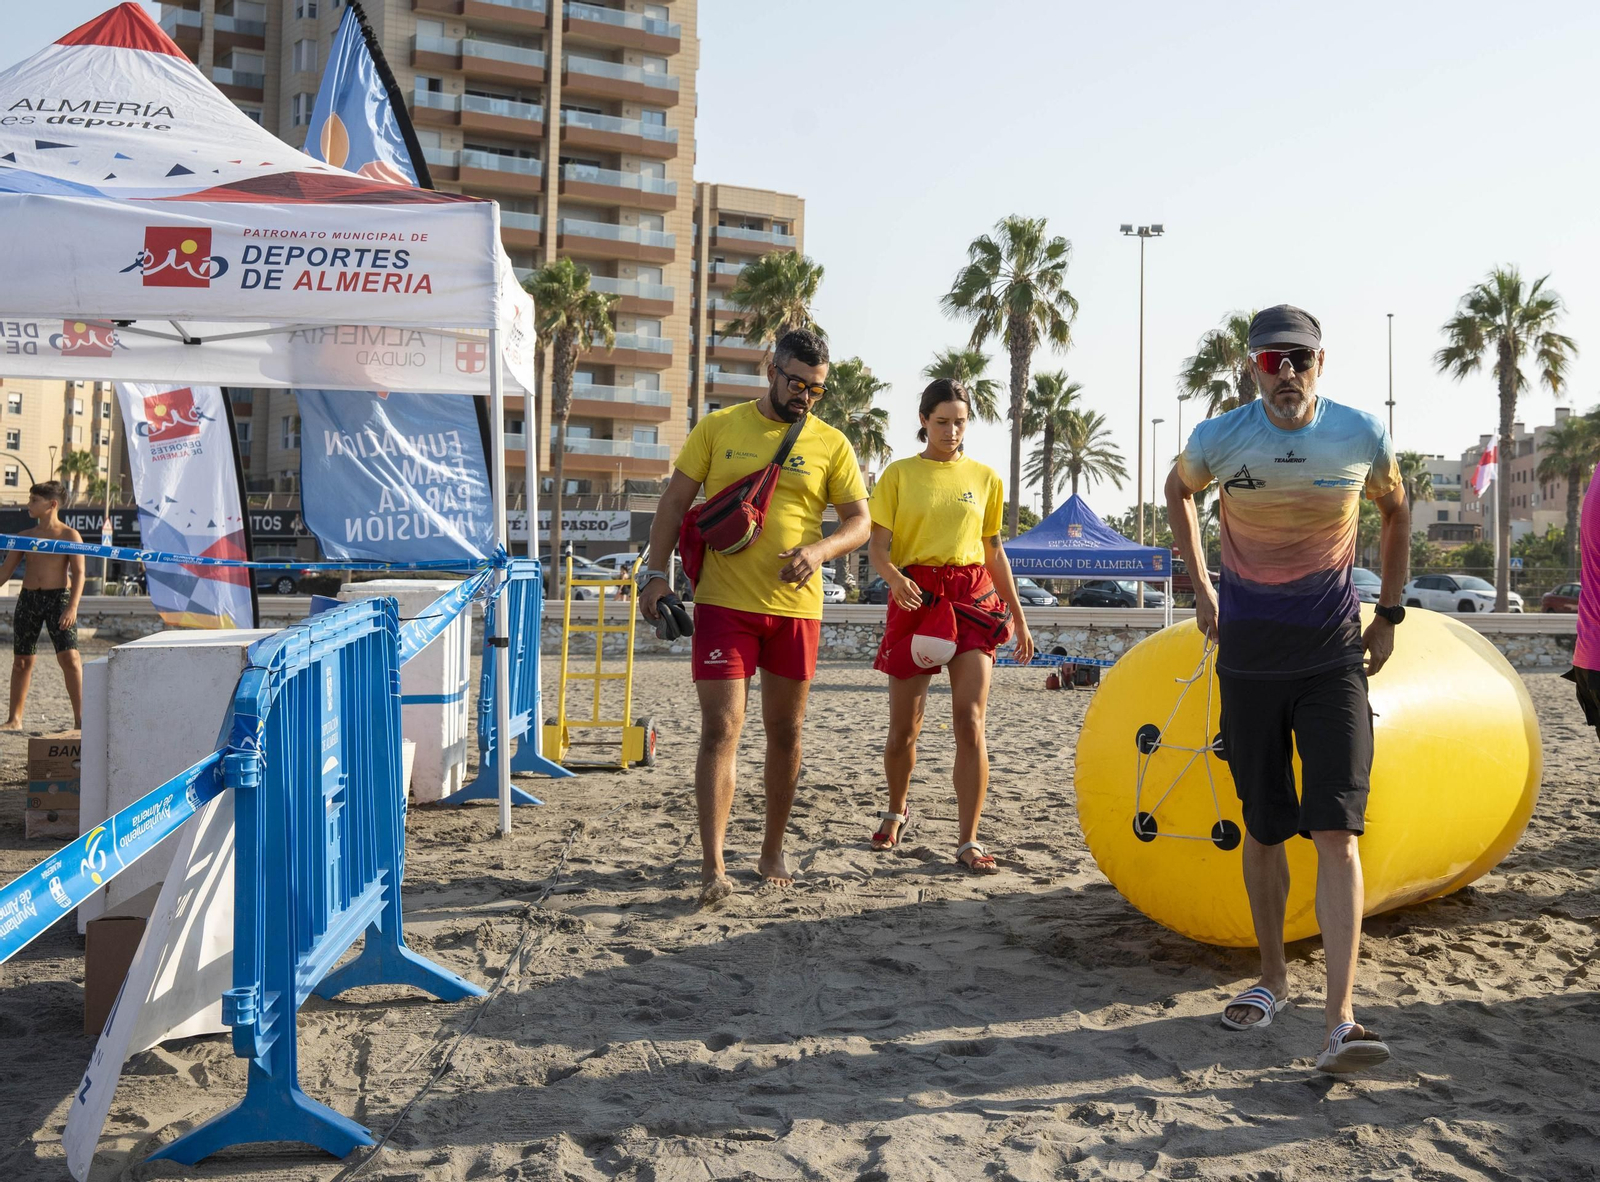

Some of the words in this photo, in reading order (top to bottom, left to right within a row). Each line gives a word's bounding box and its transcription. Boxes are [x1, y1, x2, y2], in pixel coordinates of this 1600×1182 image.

[8, 98, 175, 119] ALMERÍA
[1, 115, 37, 126] es
[46, 114, 172, 132] deporte
[243, 228, 327, 239] PATRONATO
[332, 232, 405, 241] MUNICIPAL
[411, 233, 429, 242] DE
[241, 245, 411, 270] DEPORTES
[240, 268, 284, 290] DE
[293, 270, 432, 294] ALMERIA
[561, 520, 609, 531] PASEO
[1077, 560, 1092, 569] DE
[1094, 558, 1144, 569] ALMERÍA
[120, 805, 171, 848] Ayuntamiento
[19, 889, 32, 904] de
